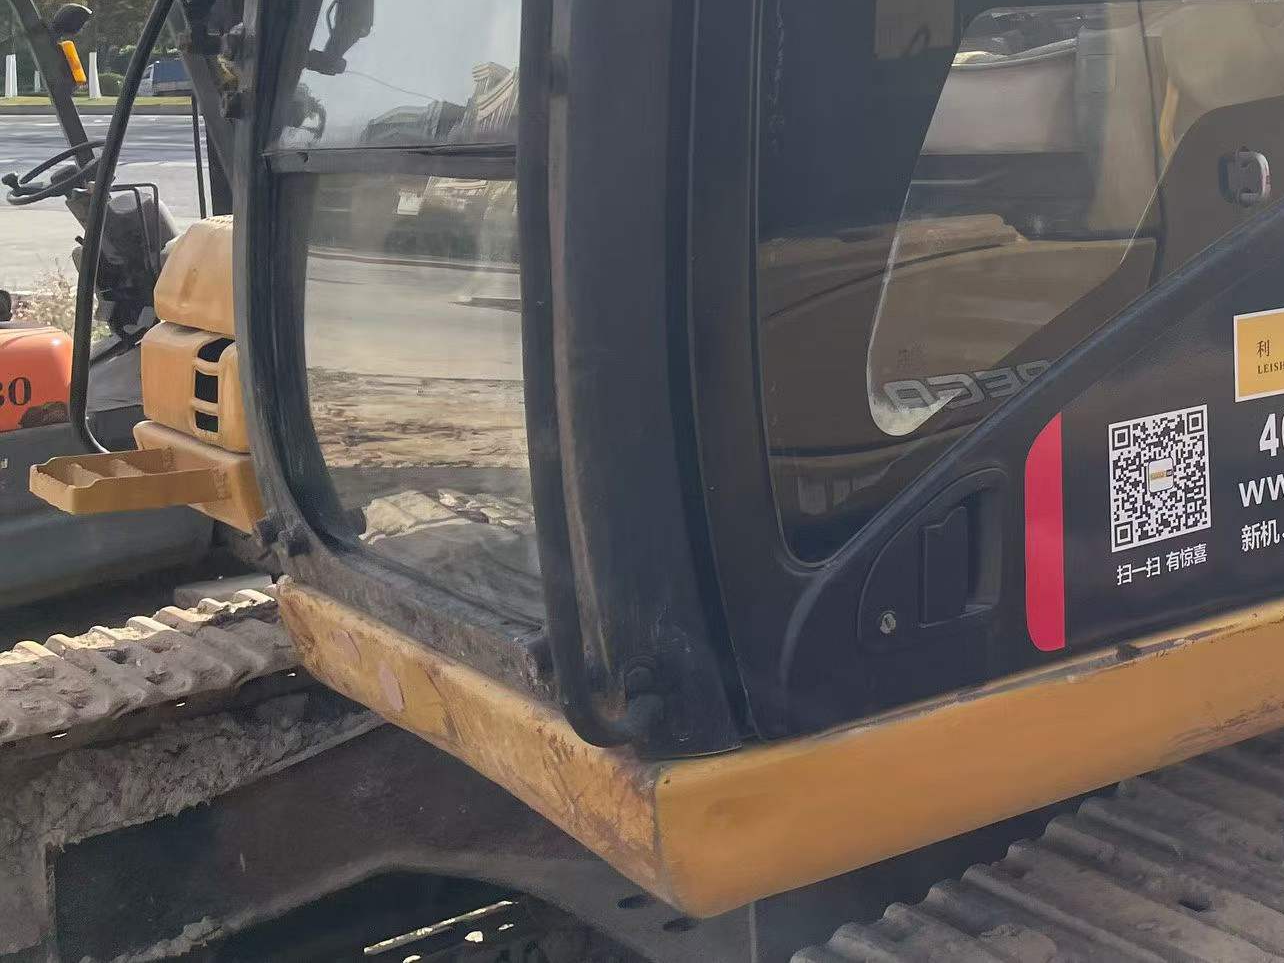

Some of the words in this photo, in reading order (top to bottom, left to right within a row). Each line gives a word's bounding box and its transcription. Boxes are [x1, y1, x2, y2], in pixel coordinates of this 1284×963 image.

[0, 377, 32, 406] 0
[1116, 556, 1161, 586] 扫一扫
[1165, 542, 1208, 572] 有惊喜
